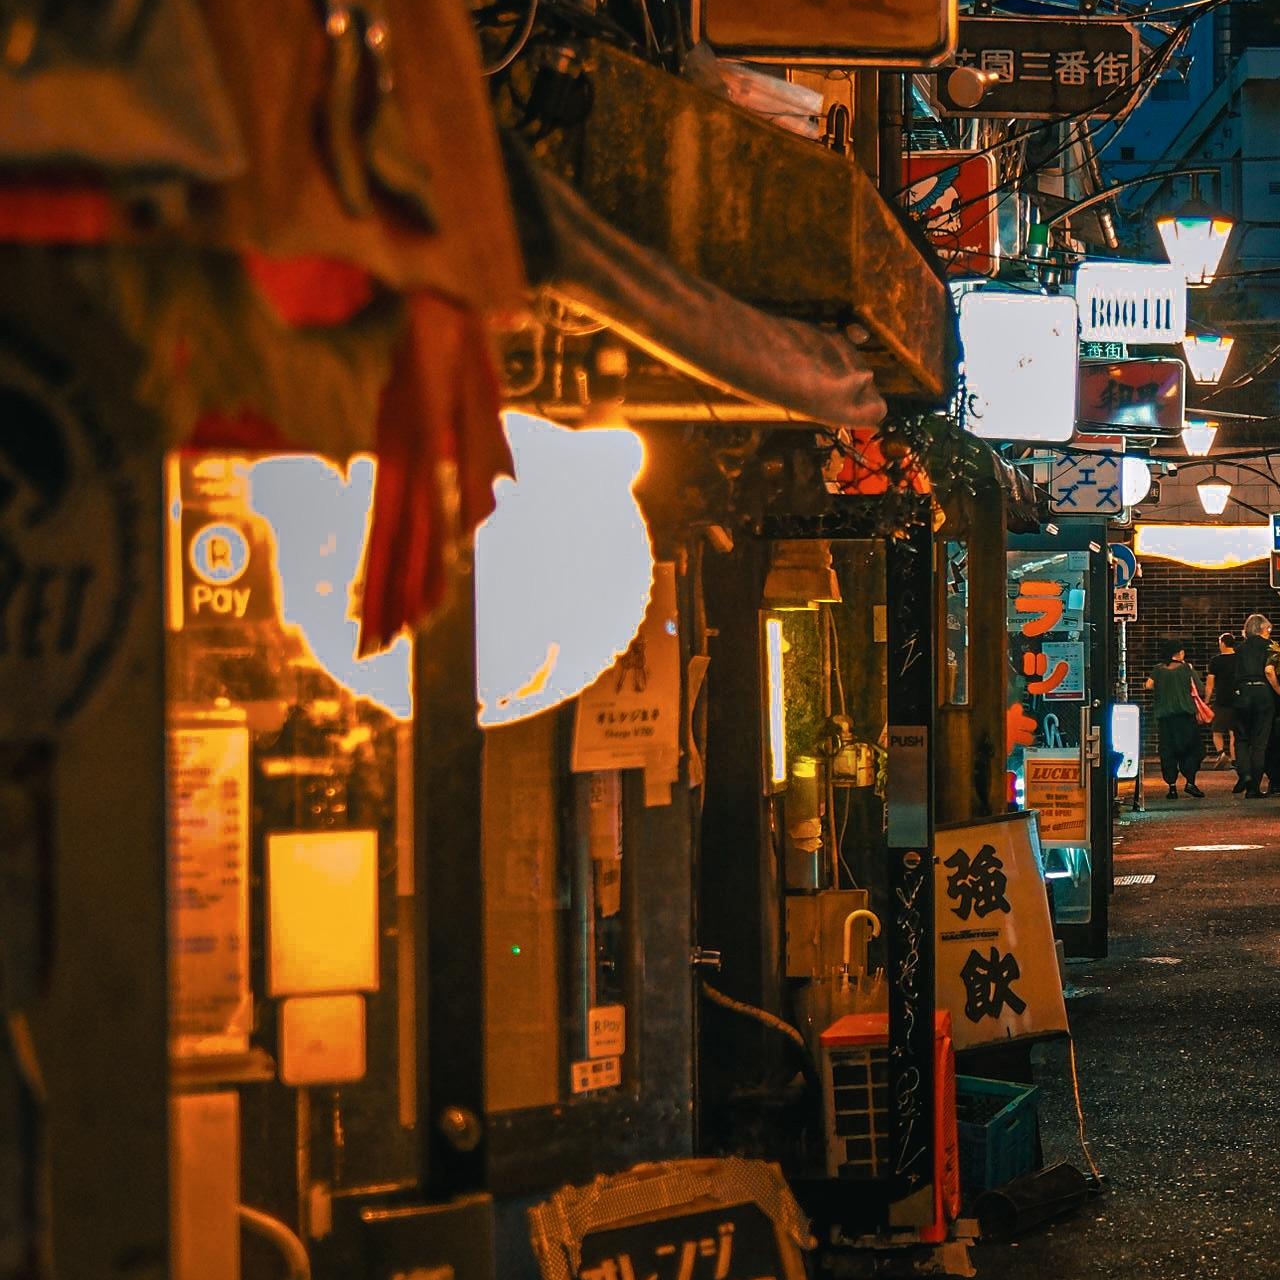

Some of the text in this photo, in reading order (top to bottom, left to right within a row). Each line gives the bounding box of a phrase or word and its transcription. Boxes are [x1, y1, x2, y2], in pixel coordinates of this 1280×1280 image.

[191, 585, 251, 619] Pay
[891, 735, 924, 747] PUSH
[1032, 767, 1080, 780] LUCKY
